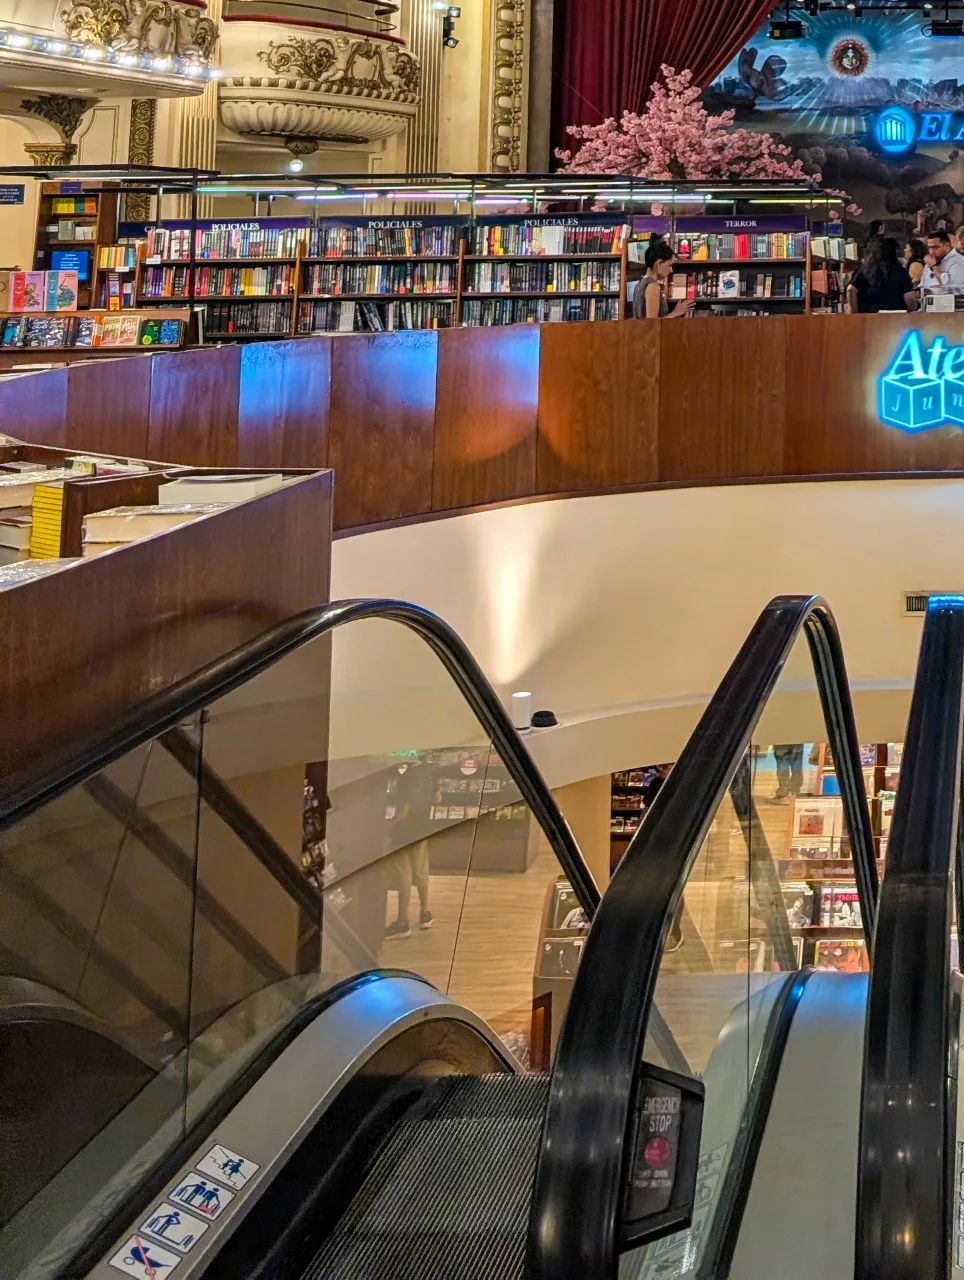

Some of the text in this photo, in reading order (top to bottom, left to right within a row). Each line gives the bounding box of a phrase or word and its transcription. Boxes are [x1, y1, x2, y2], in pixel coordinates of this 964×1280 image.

[916, 112, 951, 141] El
[212, 222, 260, 231] POLICIALES
[368, 221, 423, 229] POLICIALES
[524, 218, 579, 227] POLICIALES
[724, 220, 758, 228] TERROR
[649, 1114, 673, 1133] STOP
